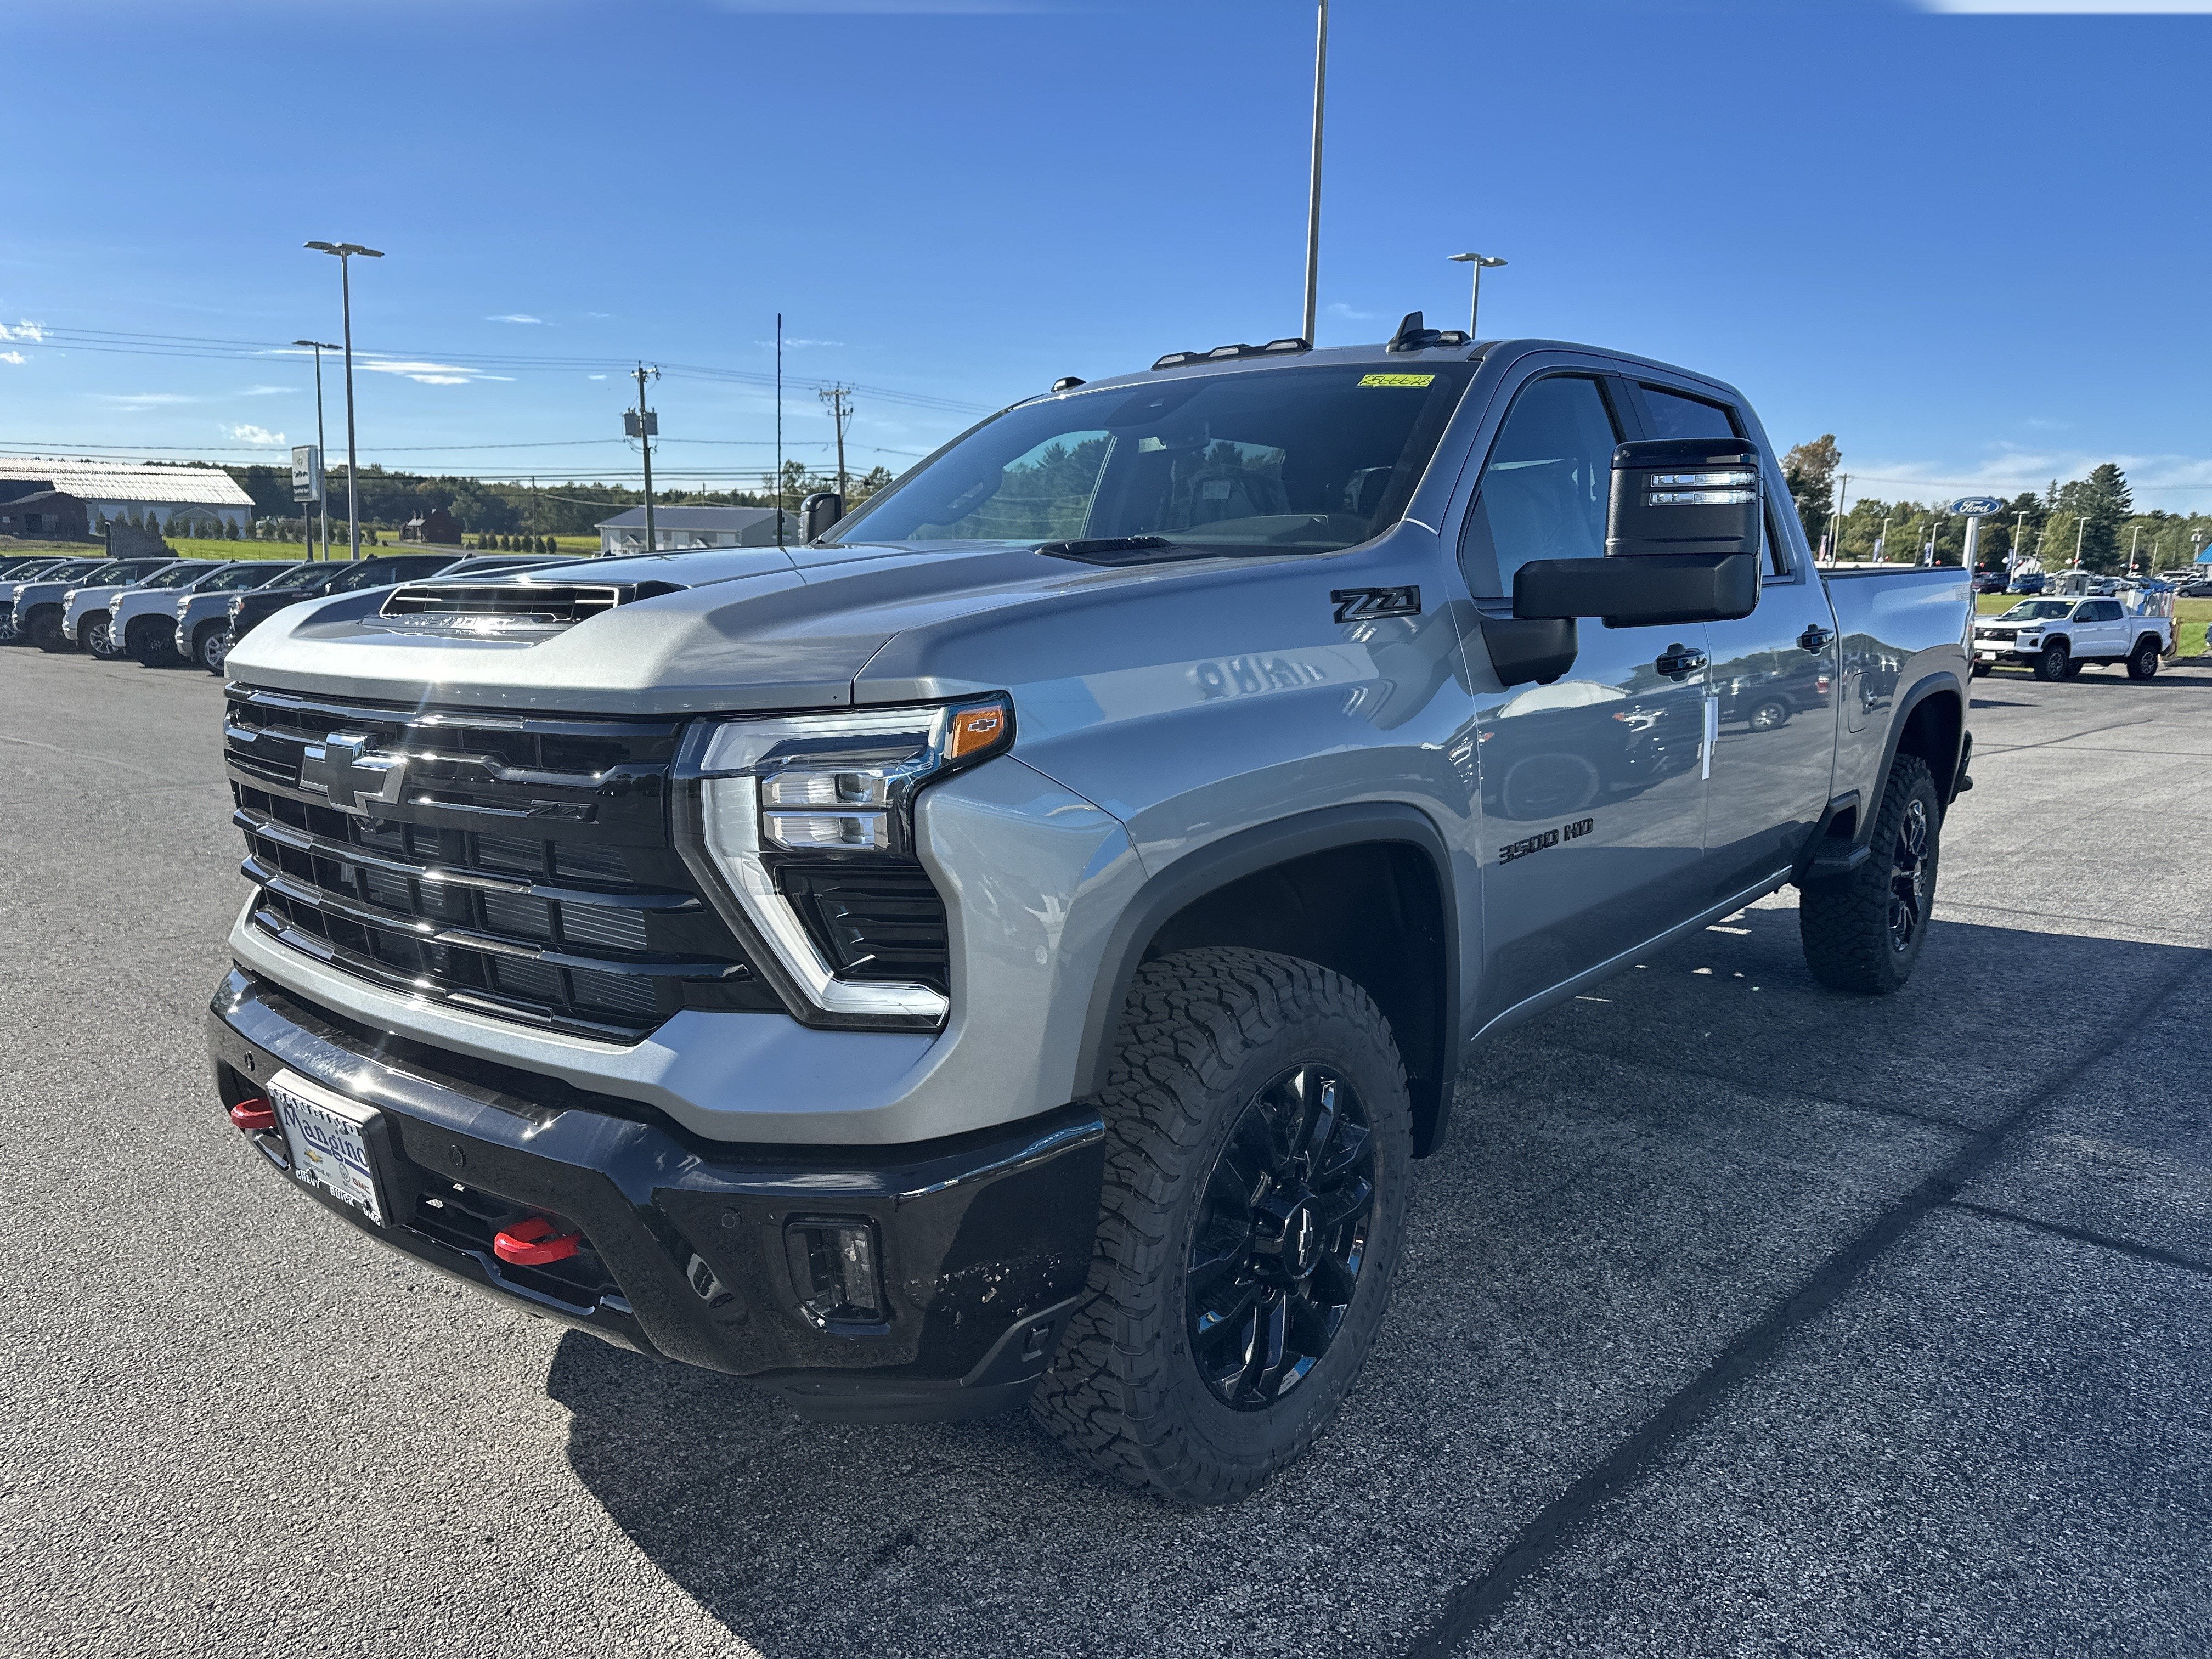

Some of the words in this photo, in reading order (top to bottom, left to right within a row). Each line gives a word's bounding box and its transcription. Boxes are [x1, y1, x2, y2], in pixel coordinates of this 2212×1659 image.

[1959, 501, 1990, 512] Ford
[1331, 585, 1421, 624] Z71
[1499, 829, 1559, 865] 3500
[1564, 817, 1593, 841] HD
[284, 1106, 369, 1168] Mangino
[295, 1170, 320, 1189] CHEVY
[329, 1186, 355, 1207] BUICK
